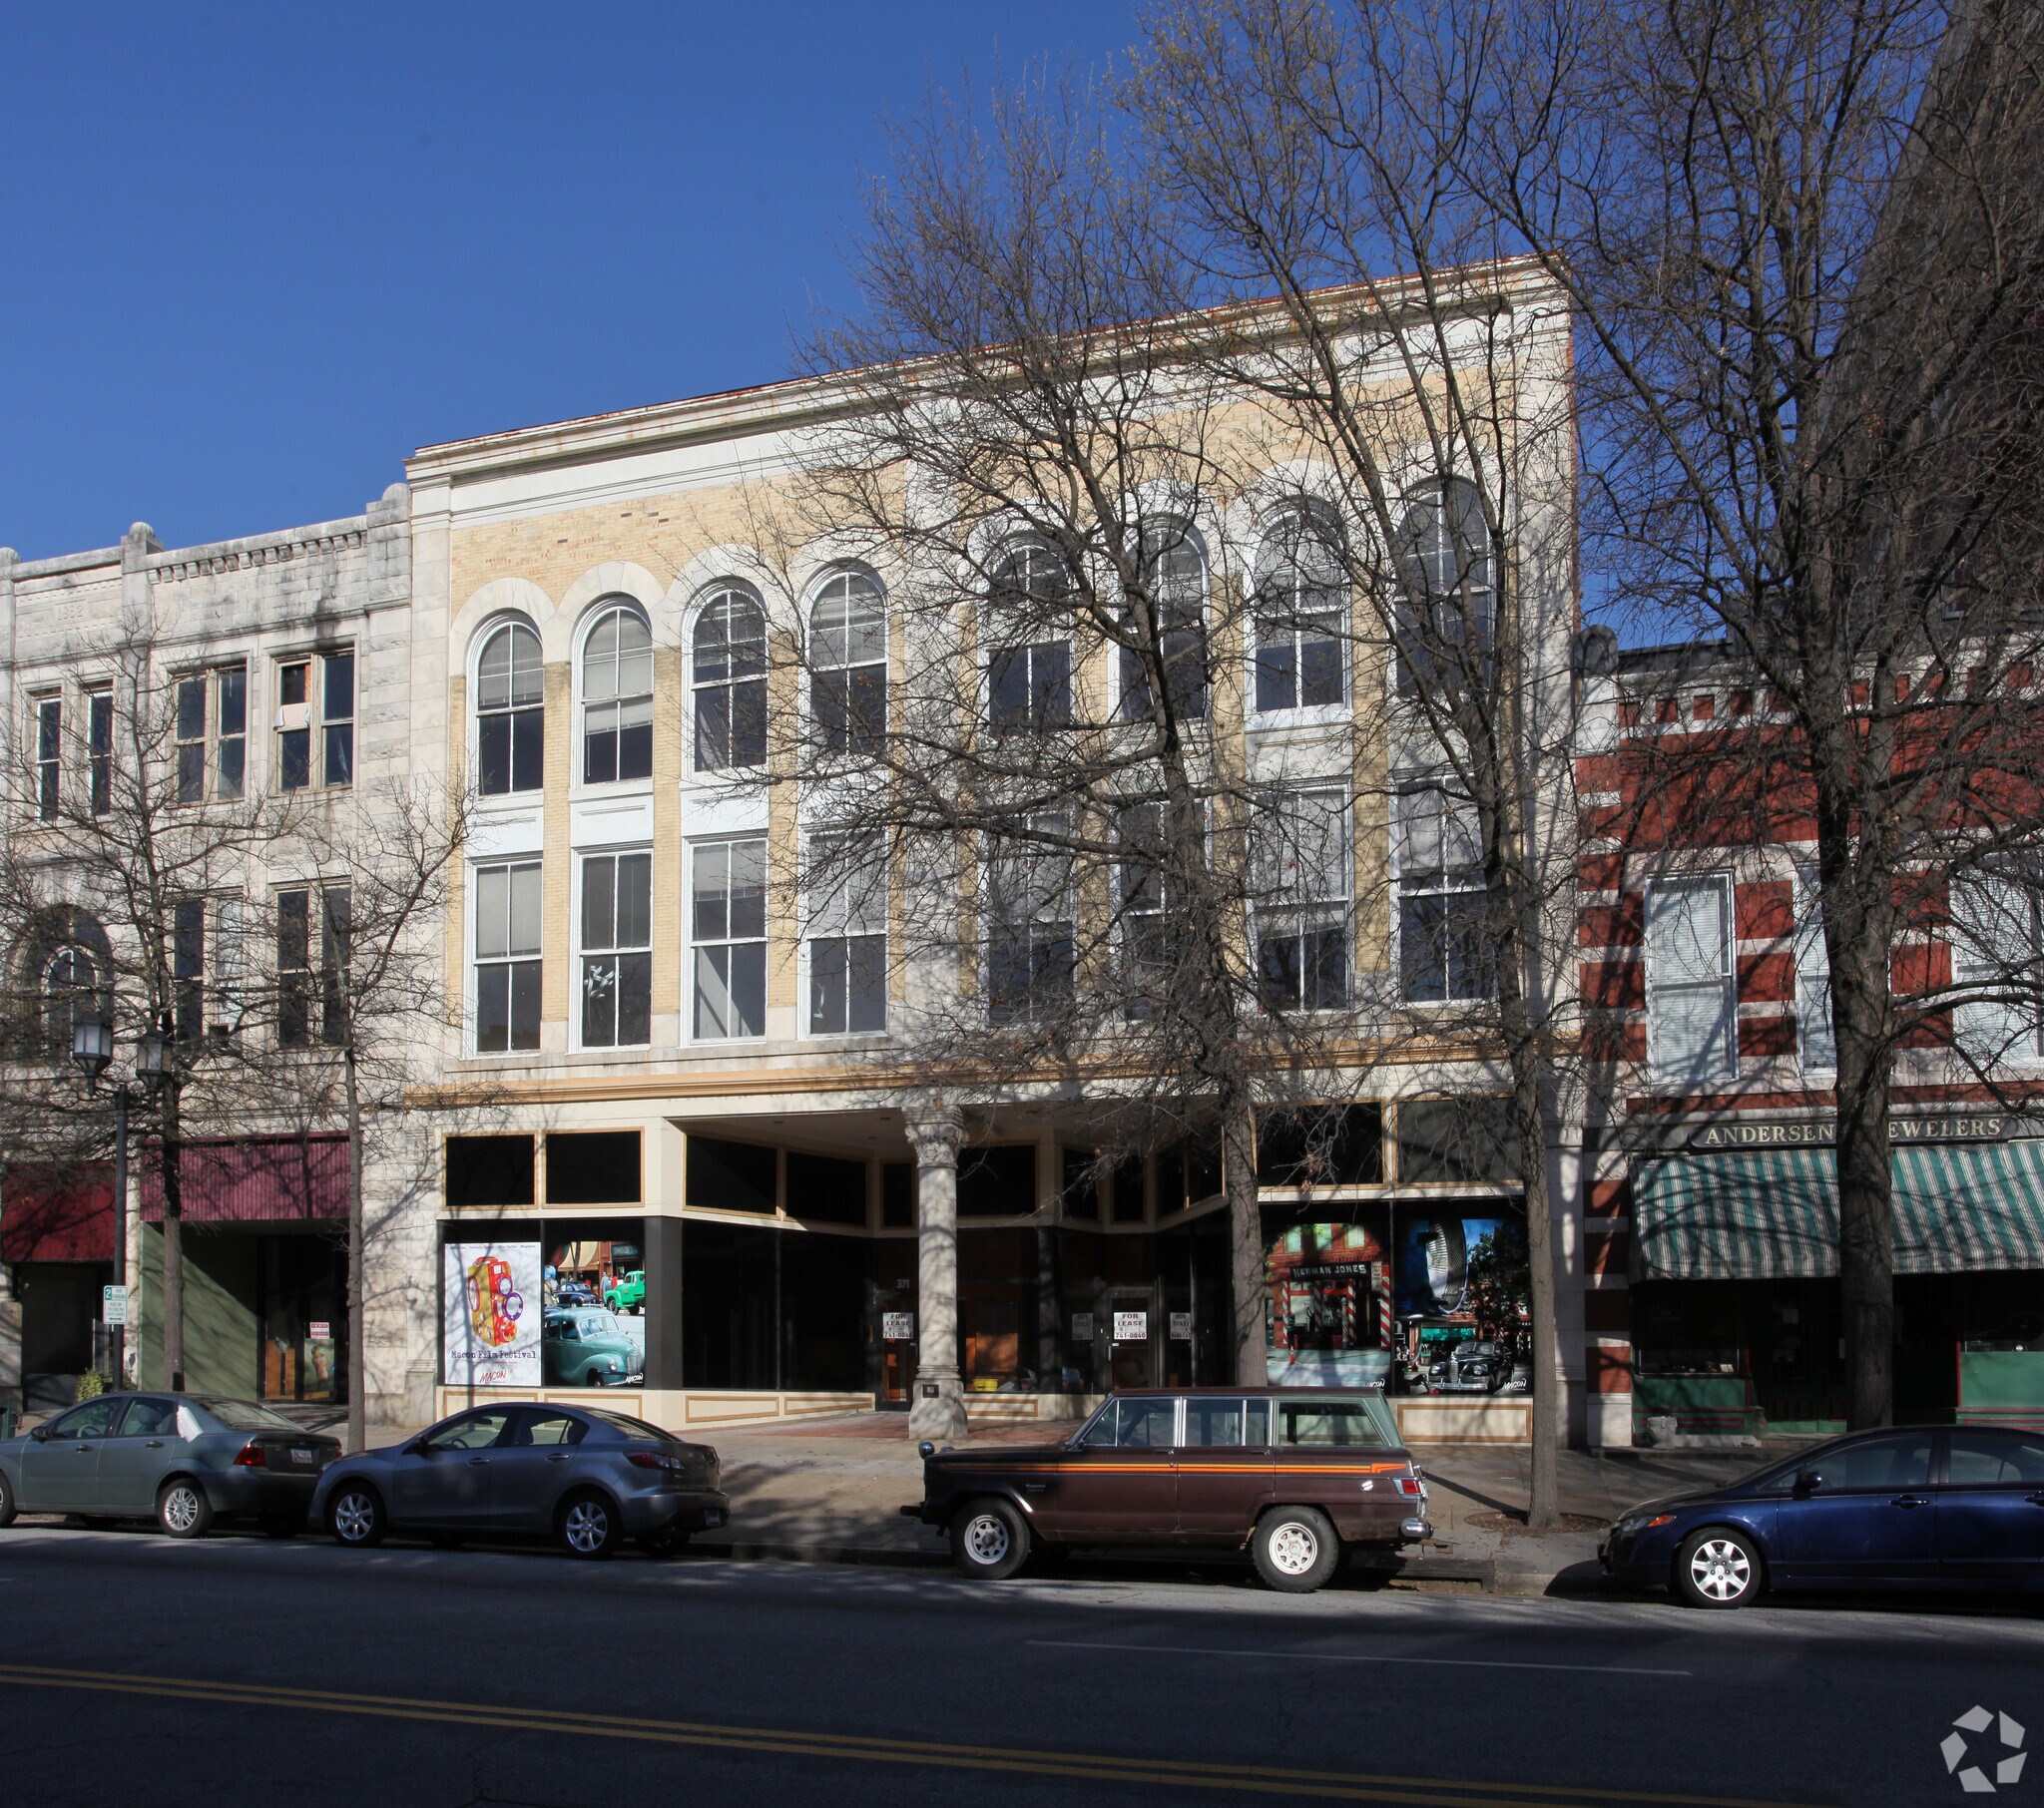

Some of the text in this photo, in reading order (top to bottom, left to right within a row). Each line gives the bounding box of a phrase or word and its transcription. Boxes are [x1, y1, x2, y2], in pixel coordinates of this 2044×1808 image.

[1705, 1119, 2001, 1145] ANDERSEN EWELERS
[1293, 1264, 1366, 1277] HERMAN JONES
[896, 1278, 910, 1289] 371
[105, 1288, 111, 1299] 2
[451, 1350, 537, 1359] Macon Film Festival
[479, 1366, 507, 1383] MACON
[624, 1372, 644, 1384] MACON
[1501, 1377, 1527, 1391] MACON
